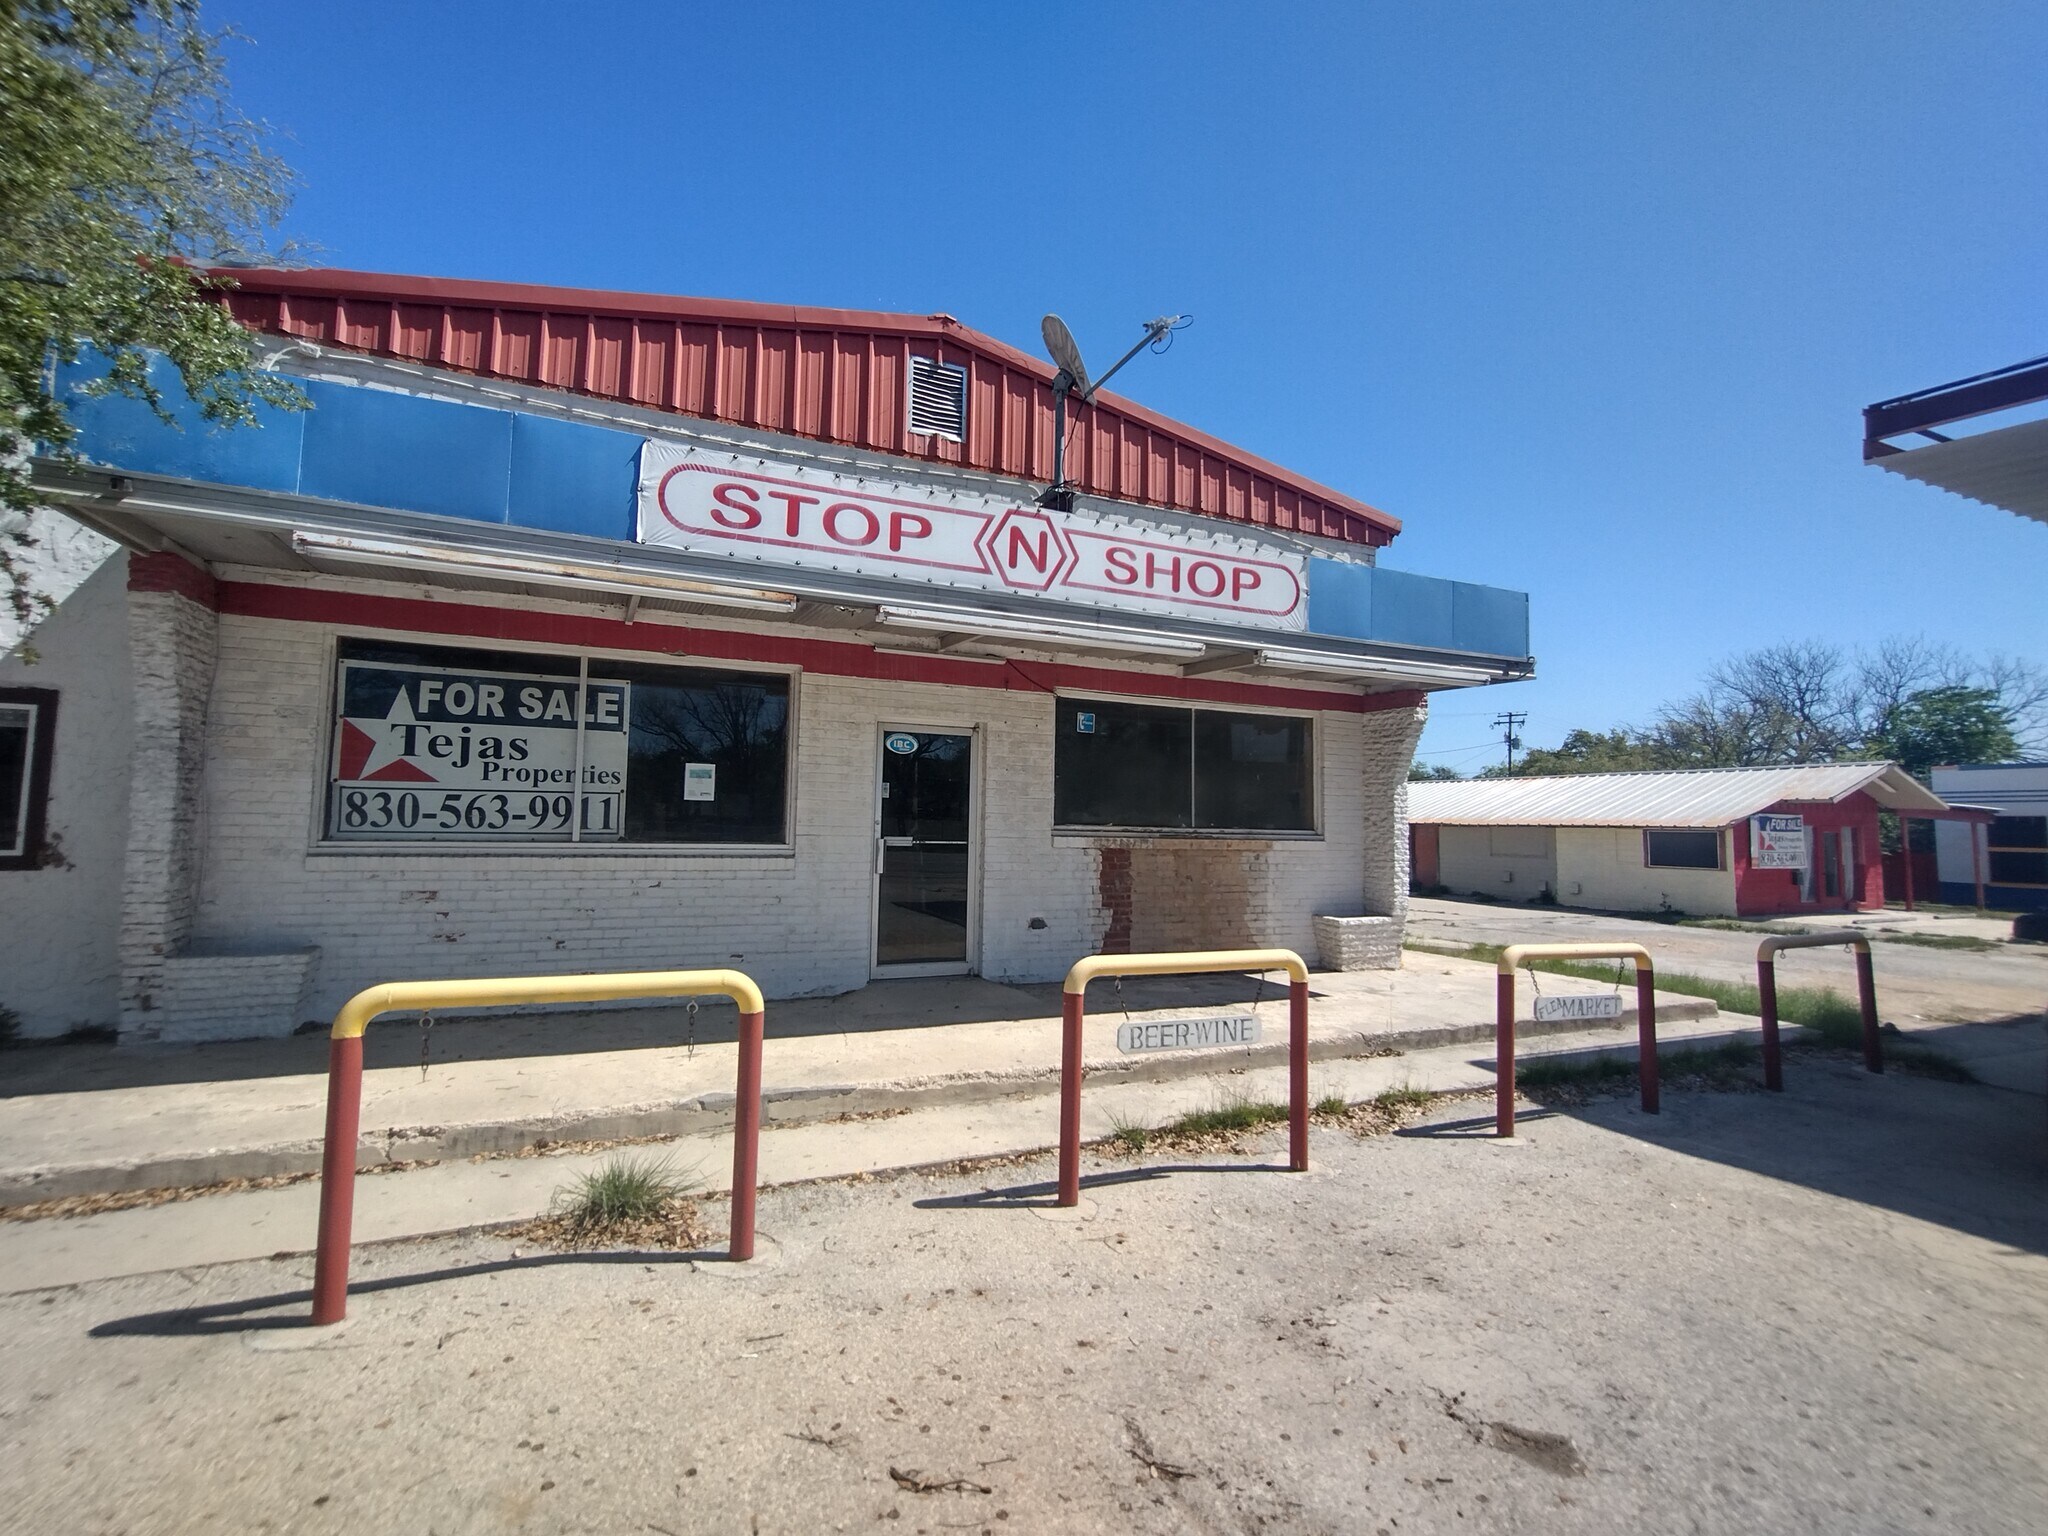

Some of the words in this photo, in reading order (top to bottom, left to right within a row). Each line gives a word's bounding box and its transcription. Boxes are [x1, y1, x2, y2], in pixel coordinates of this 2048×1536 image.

[710, 482, 933, 552] STOP
[1008, 525, 1048, 574] N
[1104, 546, 1261, 602] SHOP
[418, 680, 506, 718] FOR
[518, 688, 620, 724] SALE
[391, 723, 529, 769] Tejas
[894, 740, 910, 749] IBC
[481, 761, 622, 789] Properties
[344, 791, 616, 832] 830-563-9911
[1771, 818, 1786, 830] FOR
[1538, 997, 1562, 1020] FLEA
[1561, 997, 1622, 1018] MARKET
